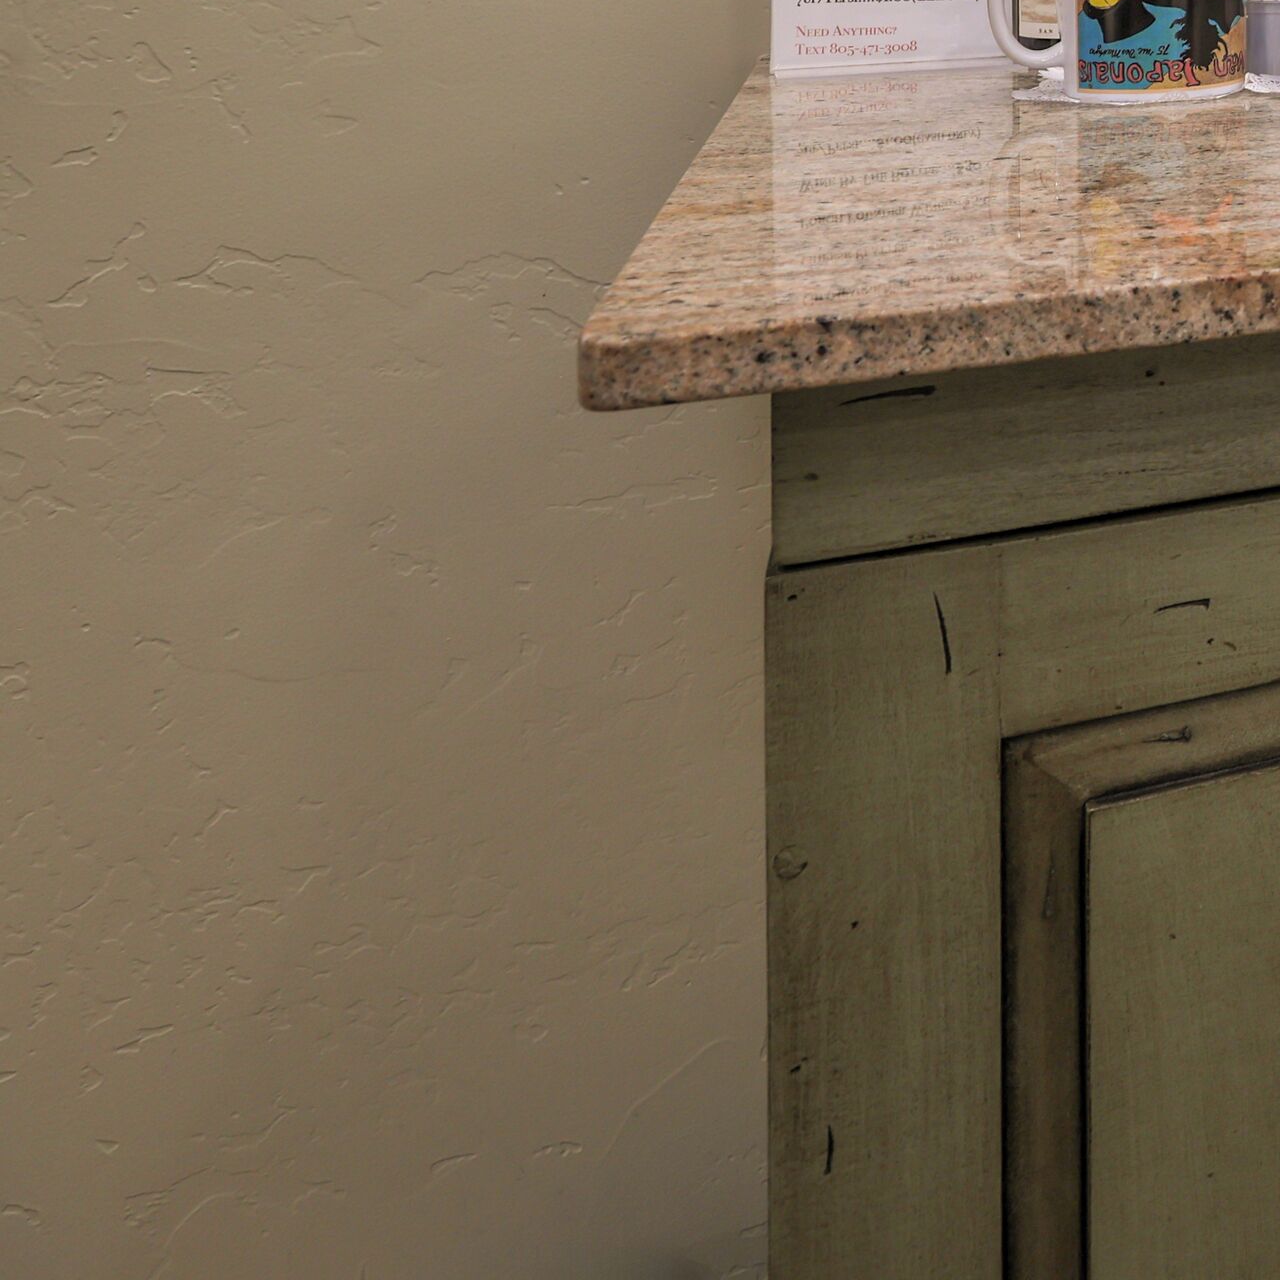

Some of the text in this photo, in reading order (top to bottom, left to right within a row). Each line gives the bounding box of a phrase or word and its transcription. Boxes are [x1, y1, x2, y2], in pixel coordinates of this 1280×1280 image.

[796, 25, 898, 38] NEED ANYTHING?
[795, 40, 918, 56] TEXT 805-471-3008
[1156, 44, 1170, 56] 75
[1212, 50, 1244, 78] van
